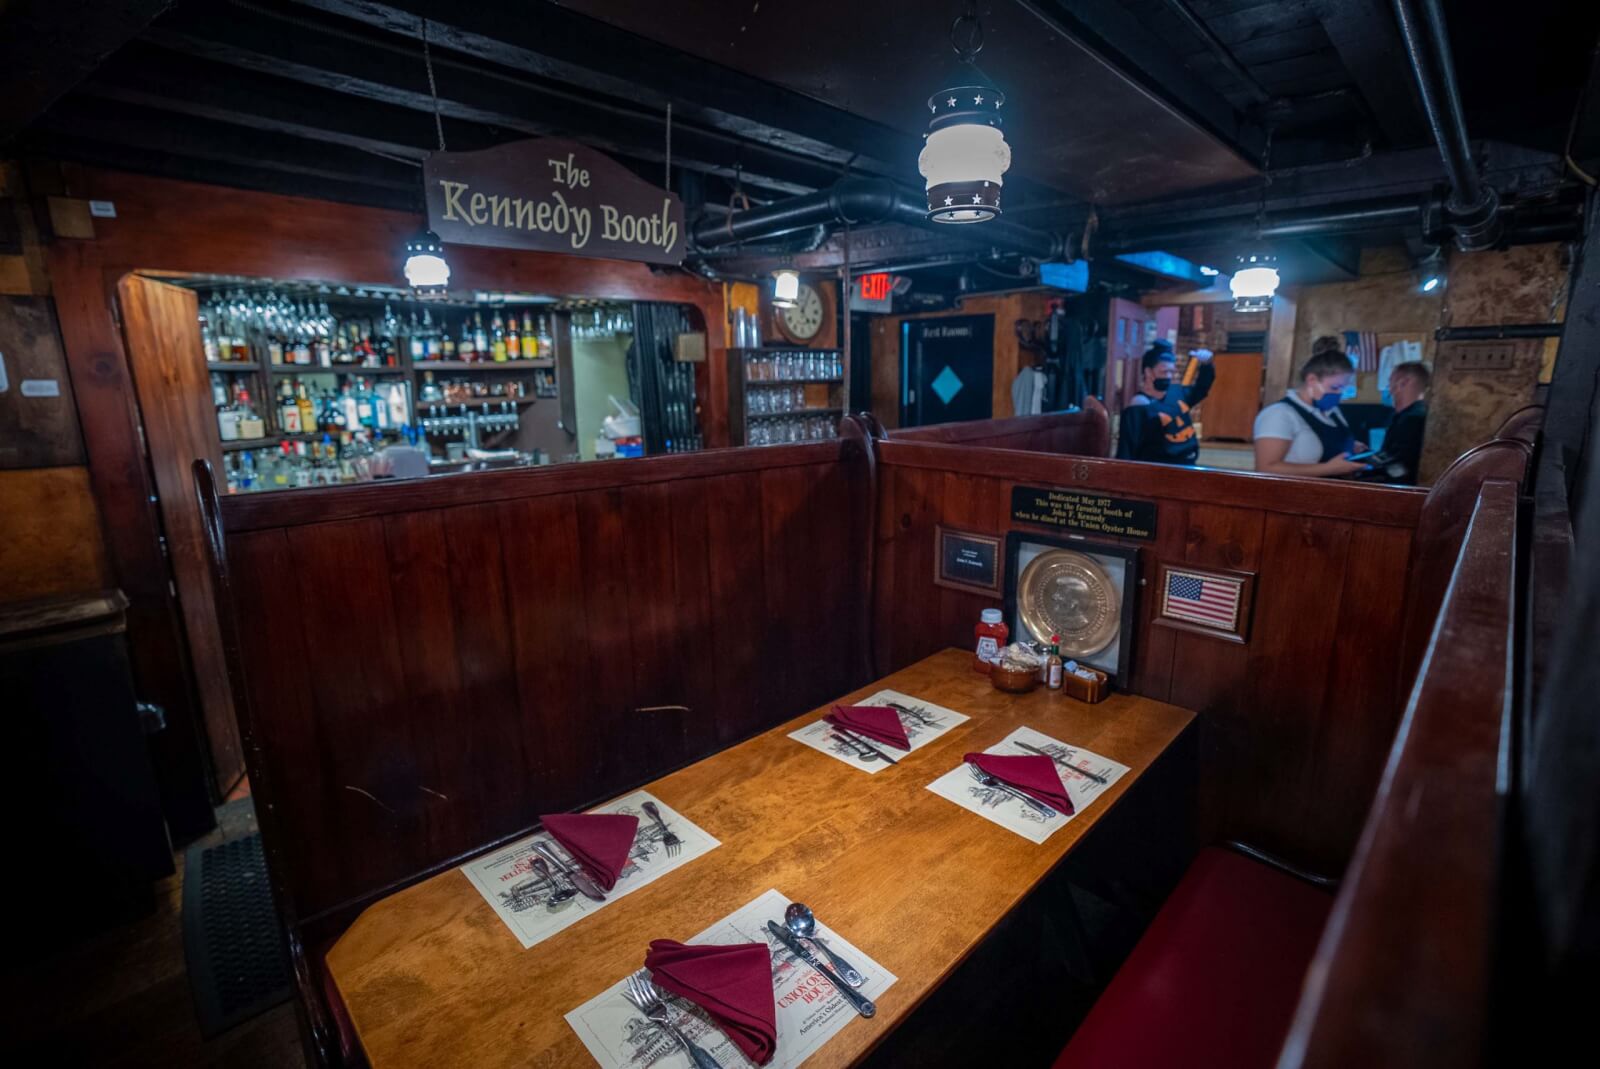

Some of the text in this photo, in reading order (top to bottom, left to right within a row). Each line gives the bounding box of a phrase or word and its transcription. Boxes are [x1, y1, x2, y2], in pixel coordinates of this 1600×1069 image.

[548, 153, 590, 189] The
[440, 180, 677, 253] Kennedy Booth
[861, 274, 888, 300] EXIT
[286, 411, 299, 430] 7
[1035, 498, 1049, 507] This
[1076, 503, 1101, 513] favorite
[1103, 507, 1123, 517] booth
[1124, 510, 1134, 518] of
[1049, 491, 1080, 503] Dedicated
[1082, 496, 1095, 506] May
[1015, 511, 1149, 537] when he dined at the Union Oyster House
[1052, 508, 1067, 517] John
[1077, 511, 1105, 524] Kennedy
[777, 983, 808, 1009] UNION
[802, 979, 832, 1005] HOUS
[799, 998, 844, 1036] America's Oldest
